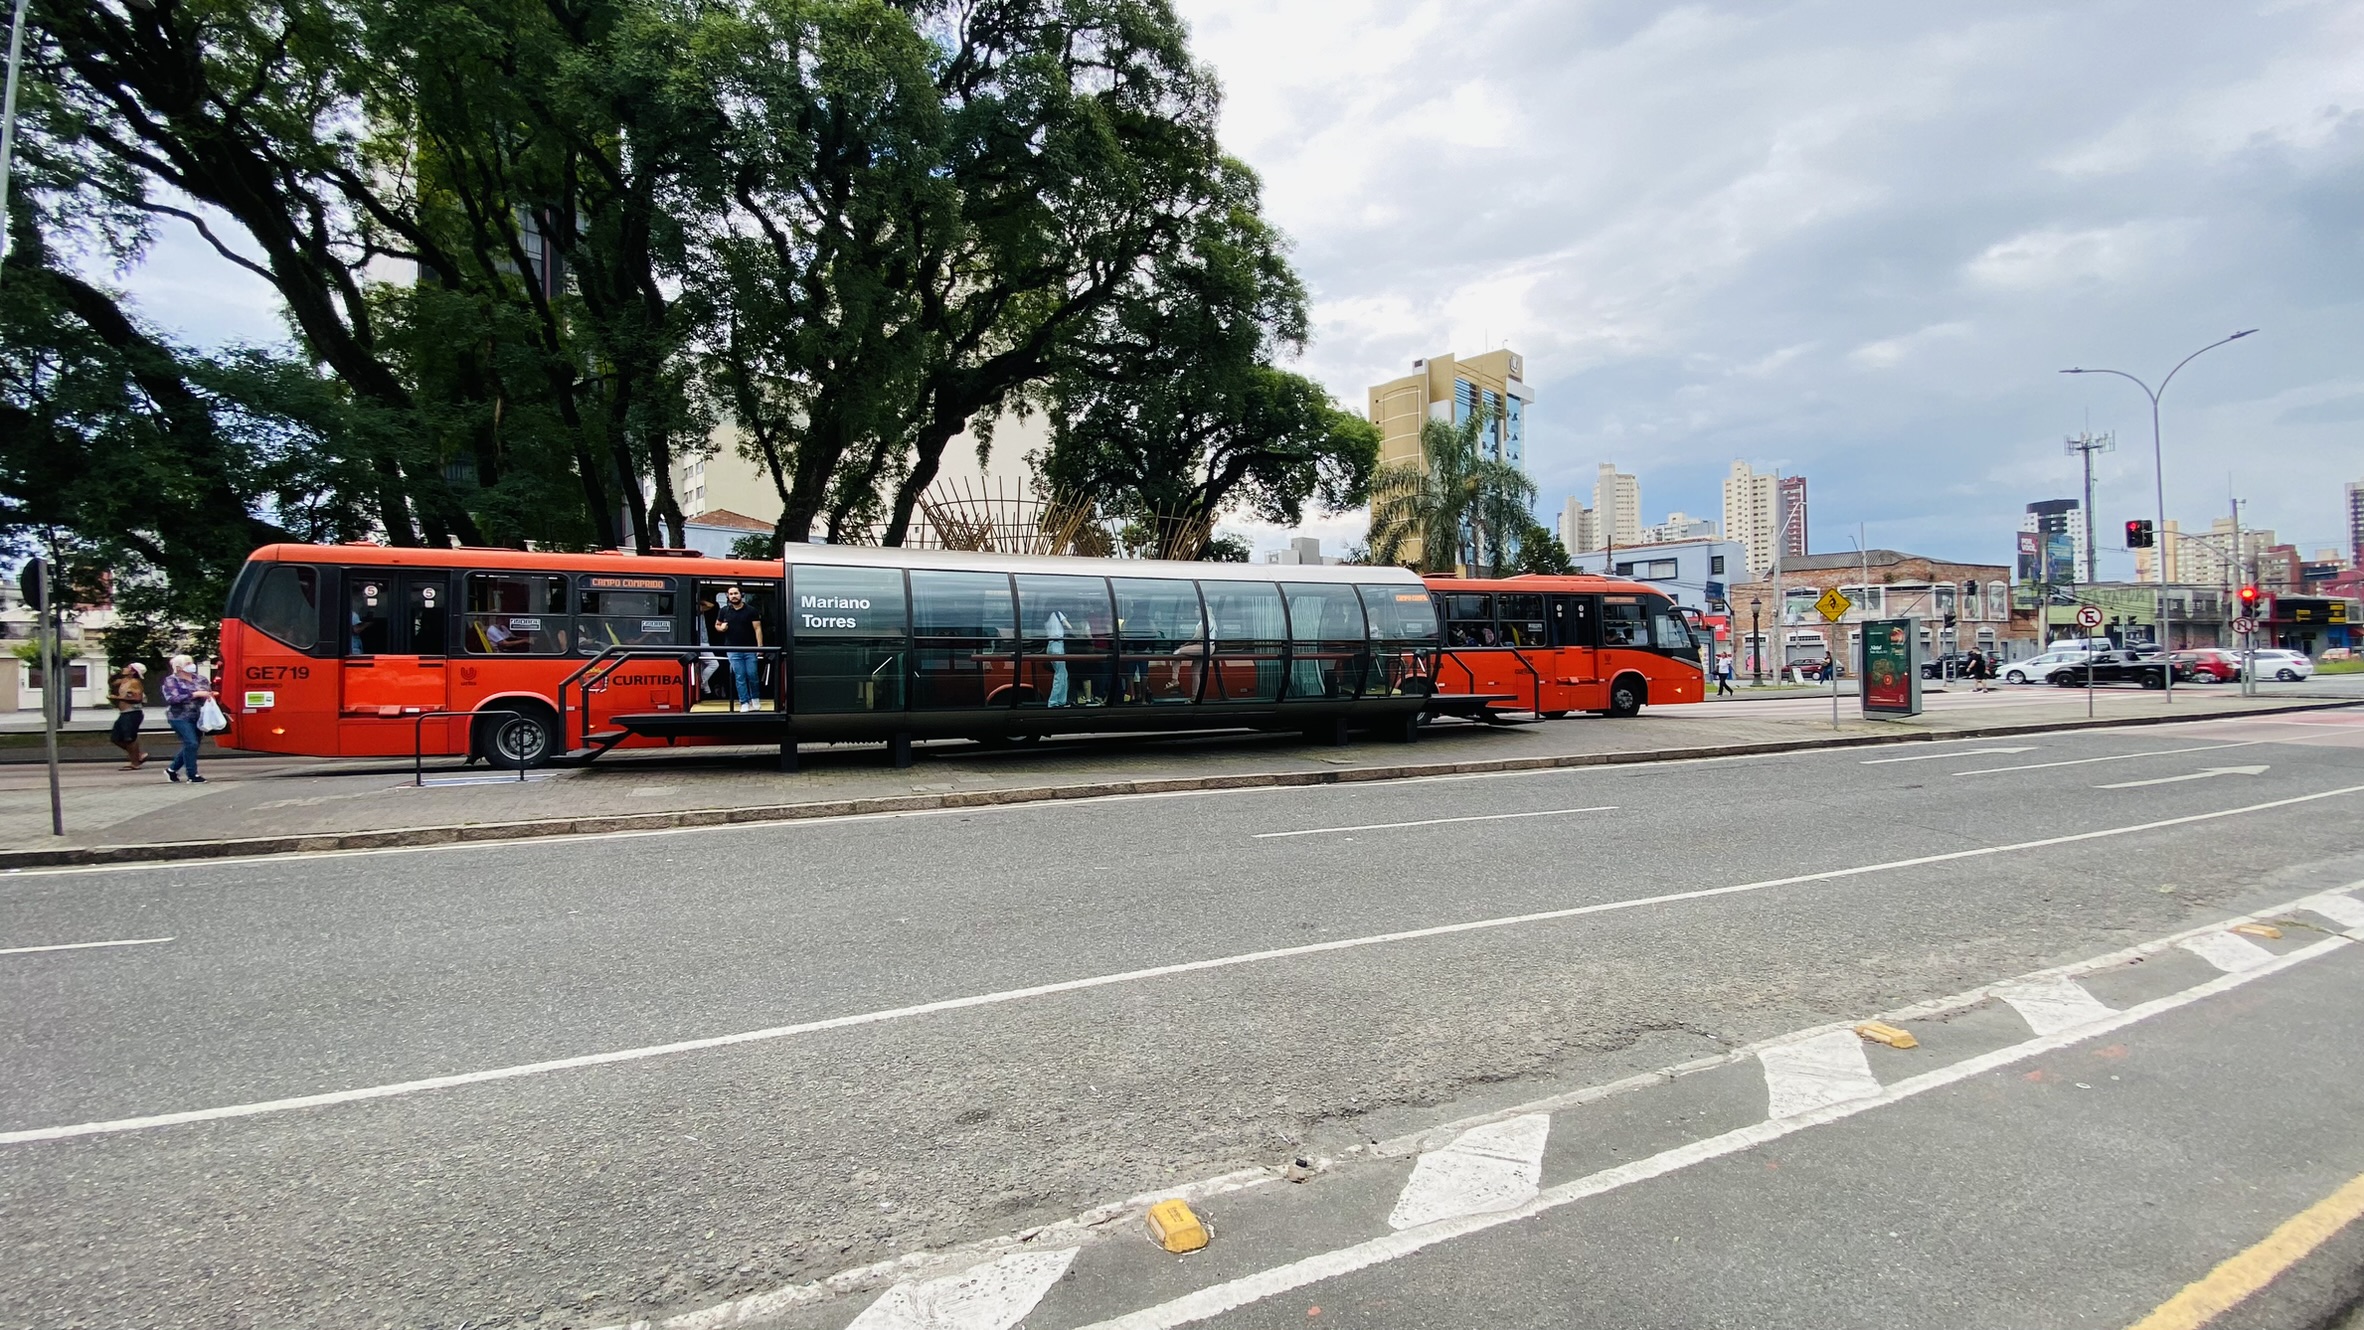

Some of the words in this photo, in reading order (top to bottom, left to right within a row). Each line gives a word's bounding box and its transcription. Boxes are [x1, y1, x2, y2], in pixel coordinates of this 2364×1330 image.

[592, 578, 620, 587] CAMPO
[622, 579, 664, 589] COMPRIDO
[801, 595, 871, 610] Mariano
[801, 613, 857, 628] Torres
[245, 666, 310, 680] GE719
[612, 675, 683, 686] CURITIBA
